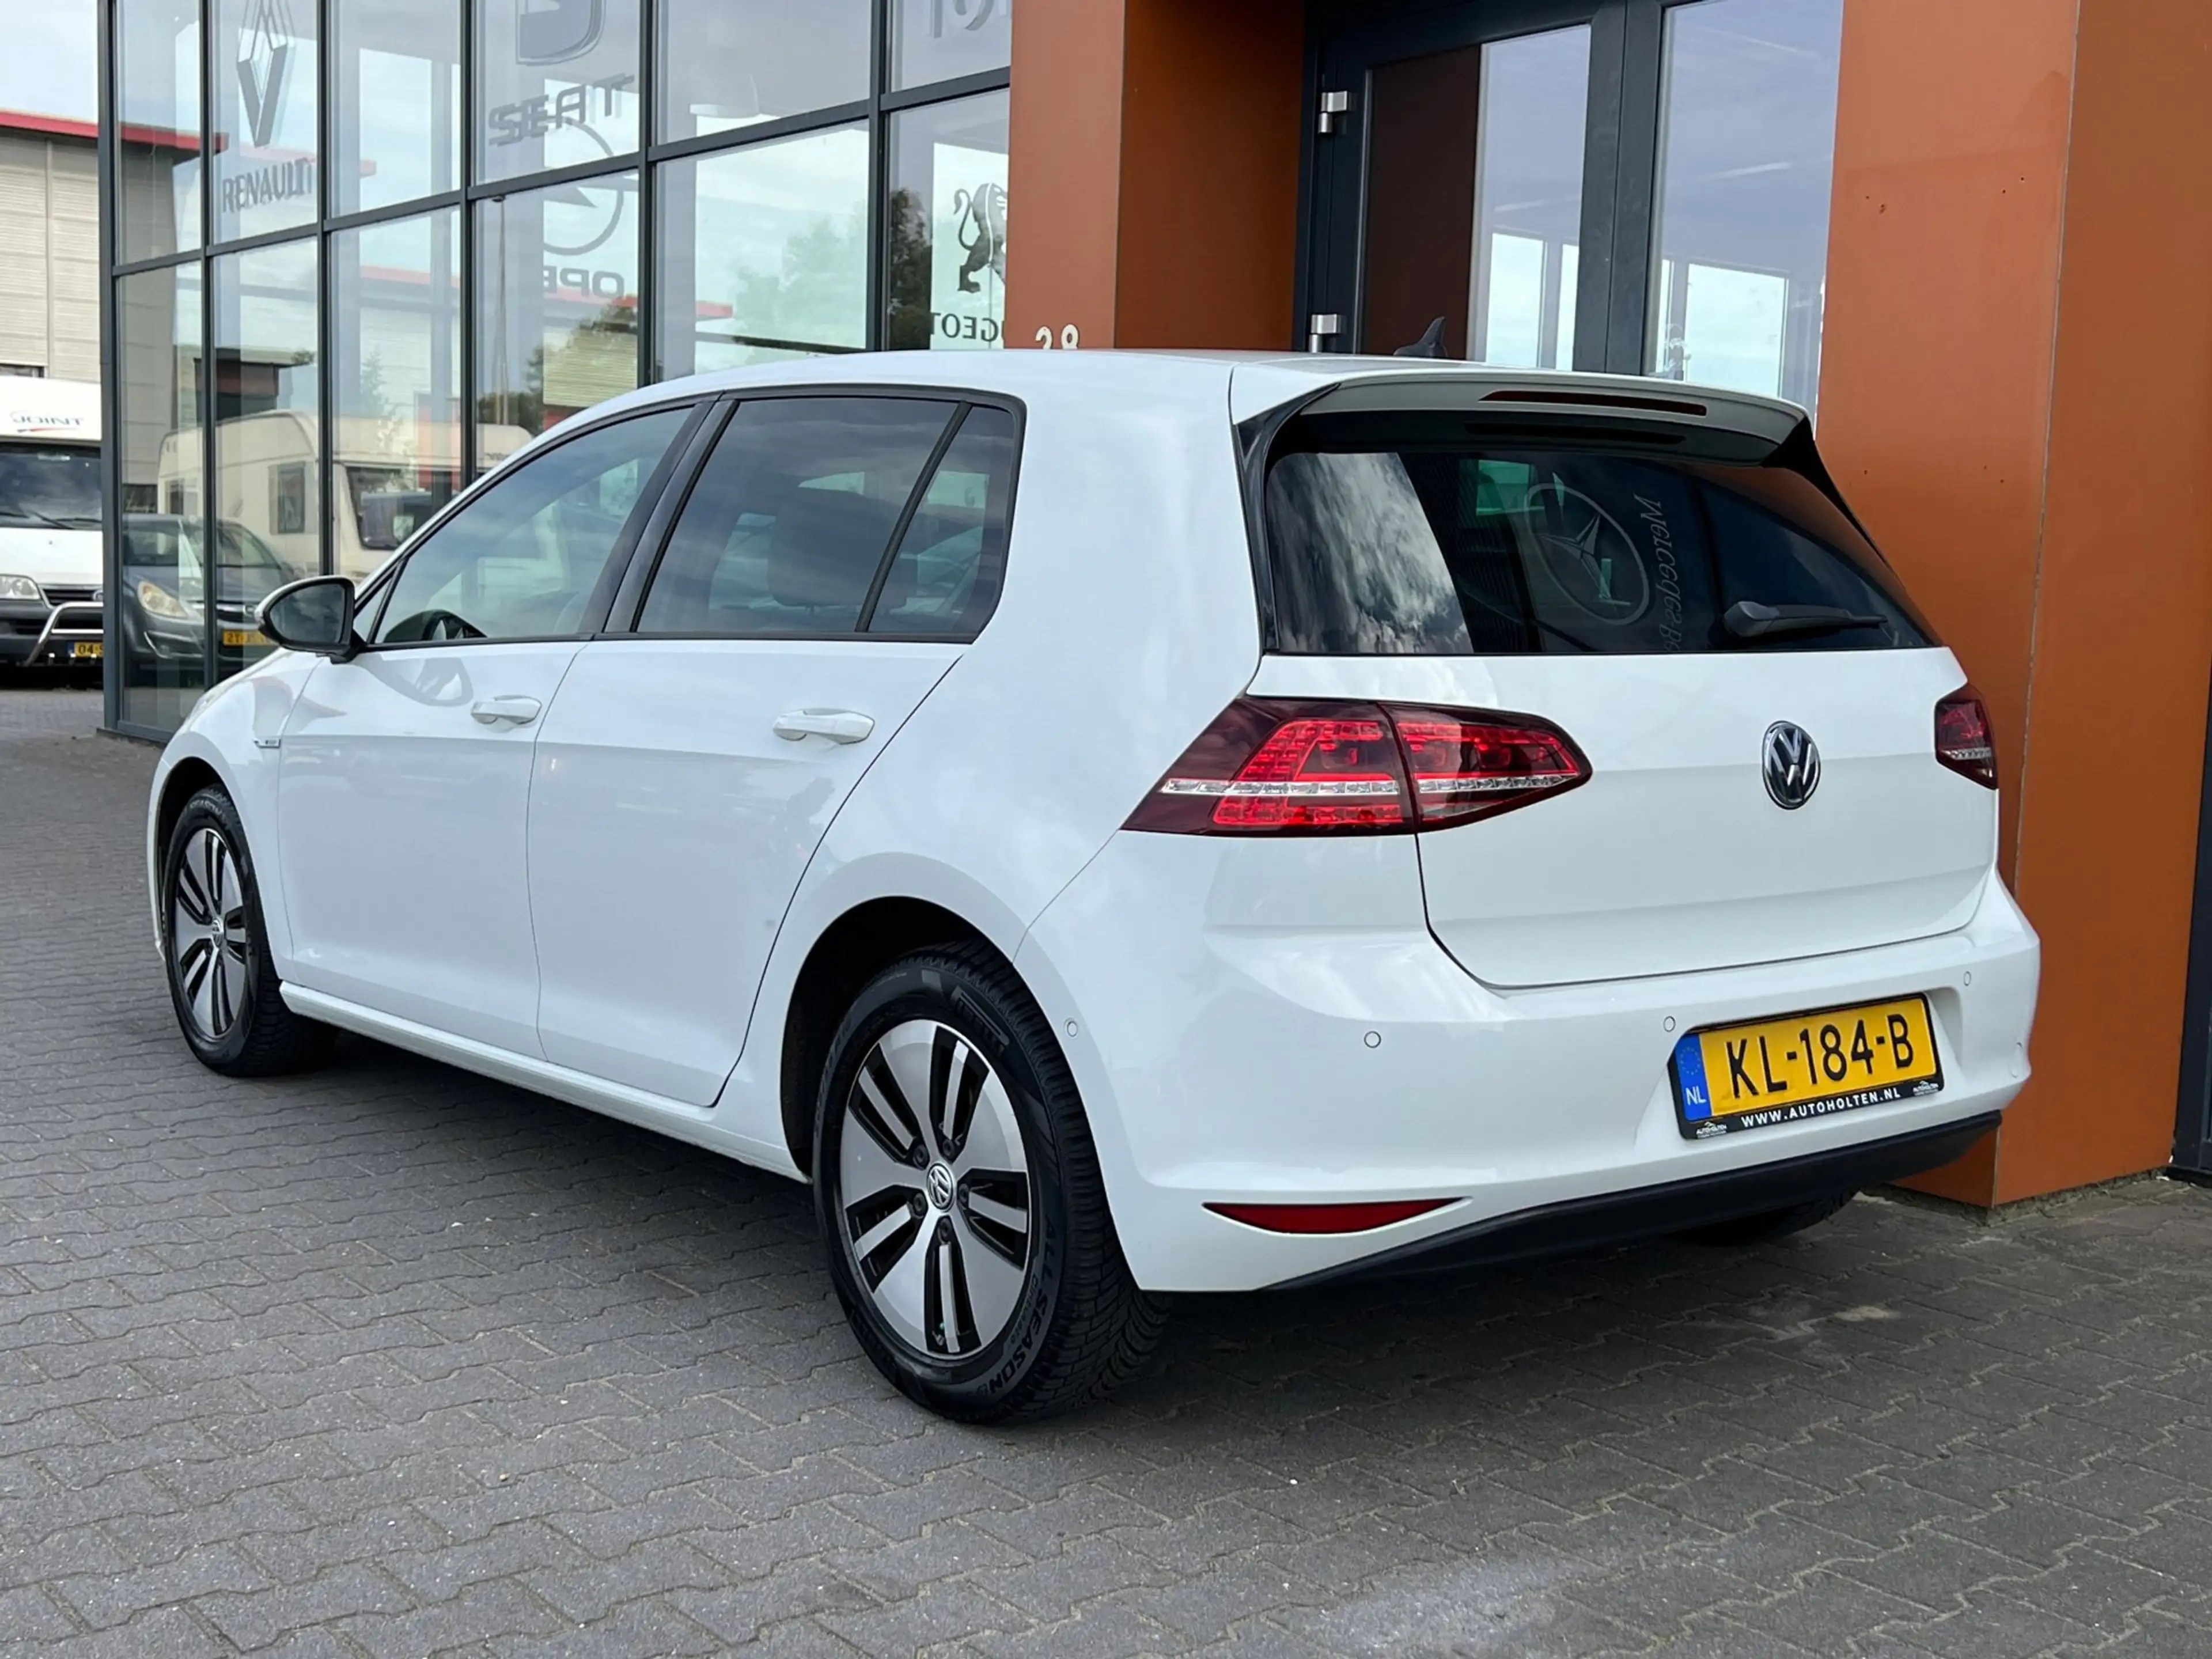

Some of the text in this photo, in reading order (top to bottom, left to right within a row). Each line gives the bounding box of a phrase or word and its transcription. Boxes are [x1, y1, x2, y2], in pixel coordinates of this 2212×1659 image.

[488, 73, 634, 146] SEAT
[222, 157, 314, 213] RENAULT
[1726, 1013, 1914, 1099] KL-184-B
[1685, 1085, 1707, 1106] NL
[1741, 1087, 1901, 1128] WWW.AUTOHOLTEN.NL
